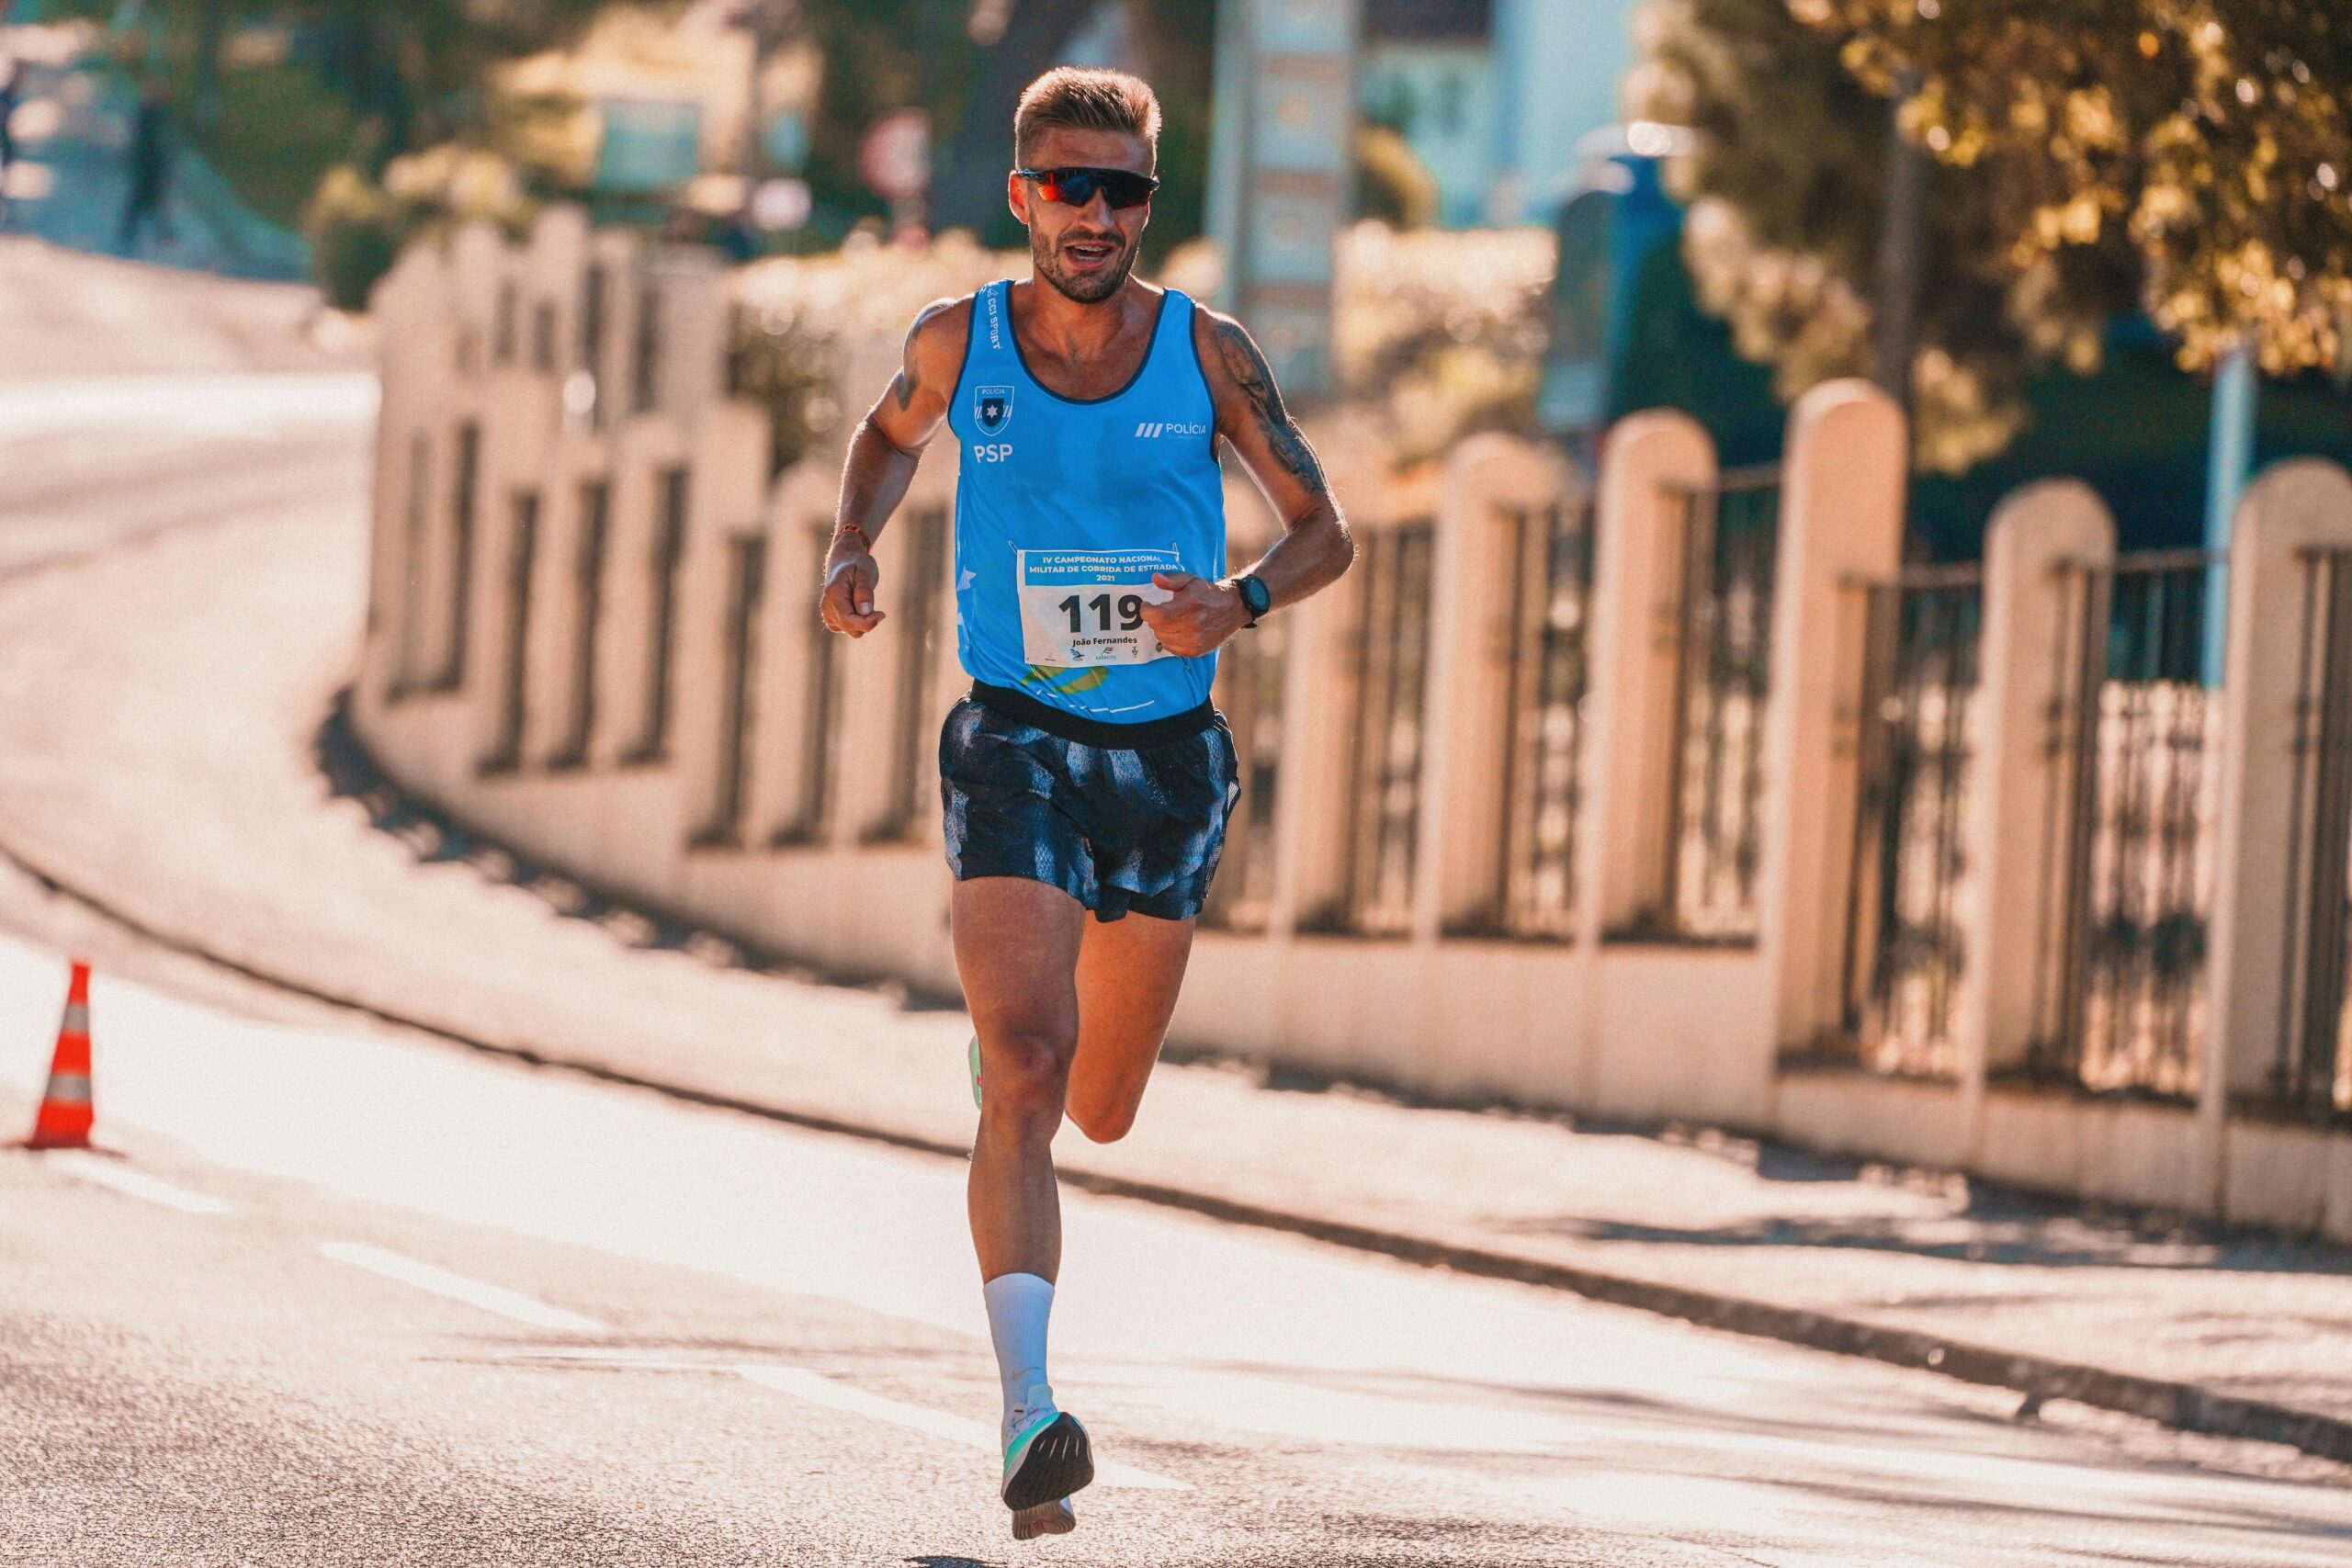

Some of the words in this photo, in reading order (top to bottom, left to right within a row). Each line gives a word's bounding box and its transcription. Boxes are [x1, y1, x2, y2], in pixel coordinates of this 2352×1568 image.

[989, 316, 1001, 349] SPORT
[1166, 422, 1206, 434] POLÍCIA
[974, 444, 1012, 463] PSP
[1055, 556, 1117, 564] CAMPEONATO
[1118, 555, 1162, 563] NACIONAL
[1080, 565, 1121, 573] CORRIDA
[1124, 565, 1136, 573] DE
[1137, 563, 1178, 572] ESTRADA
[1058, 593, 1145, 633] 119
[1072, 637, 1091, 648] João
[1092, 636, 1137, 645] Fernandes
